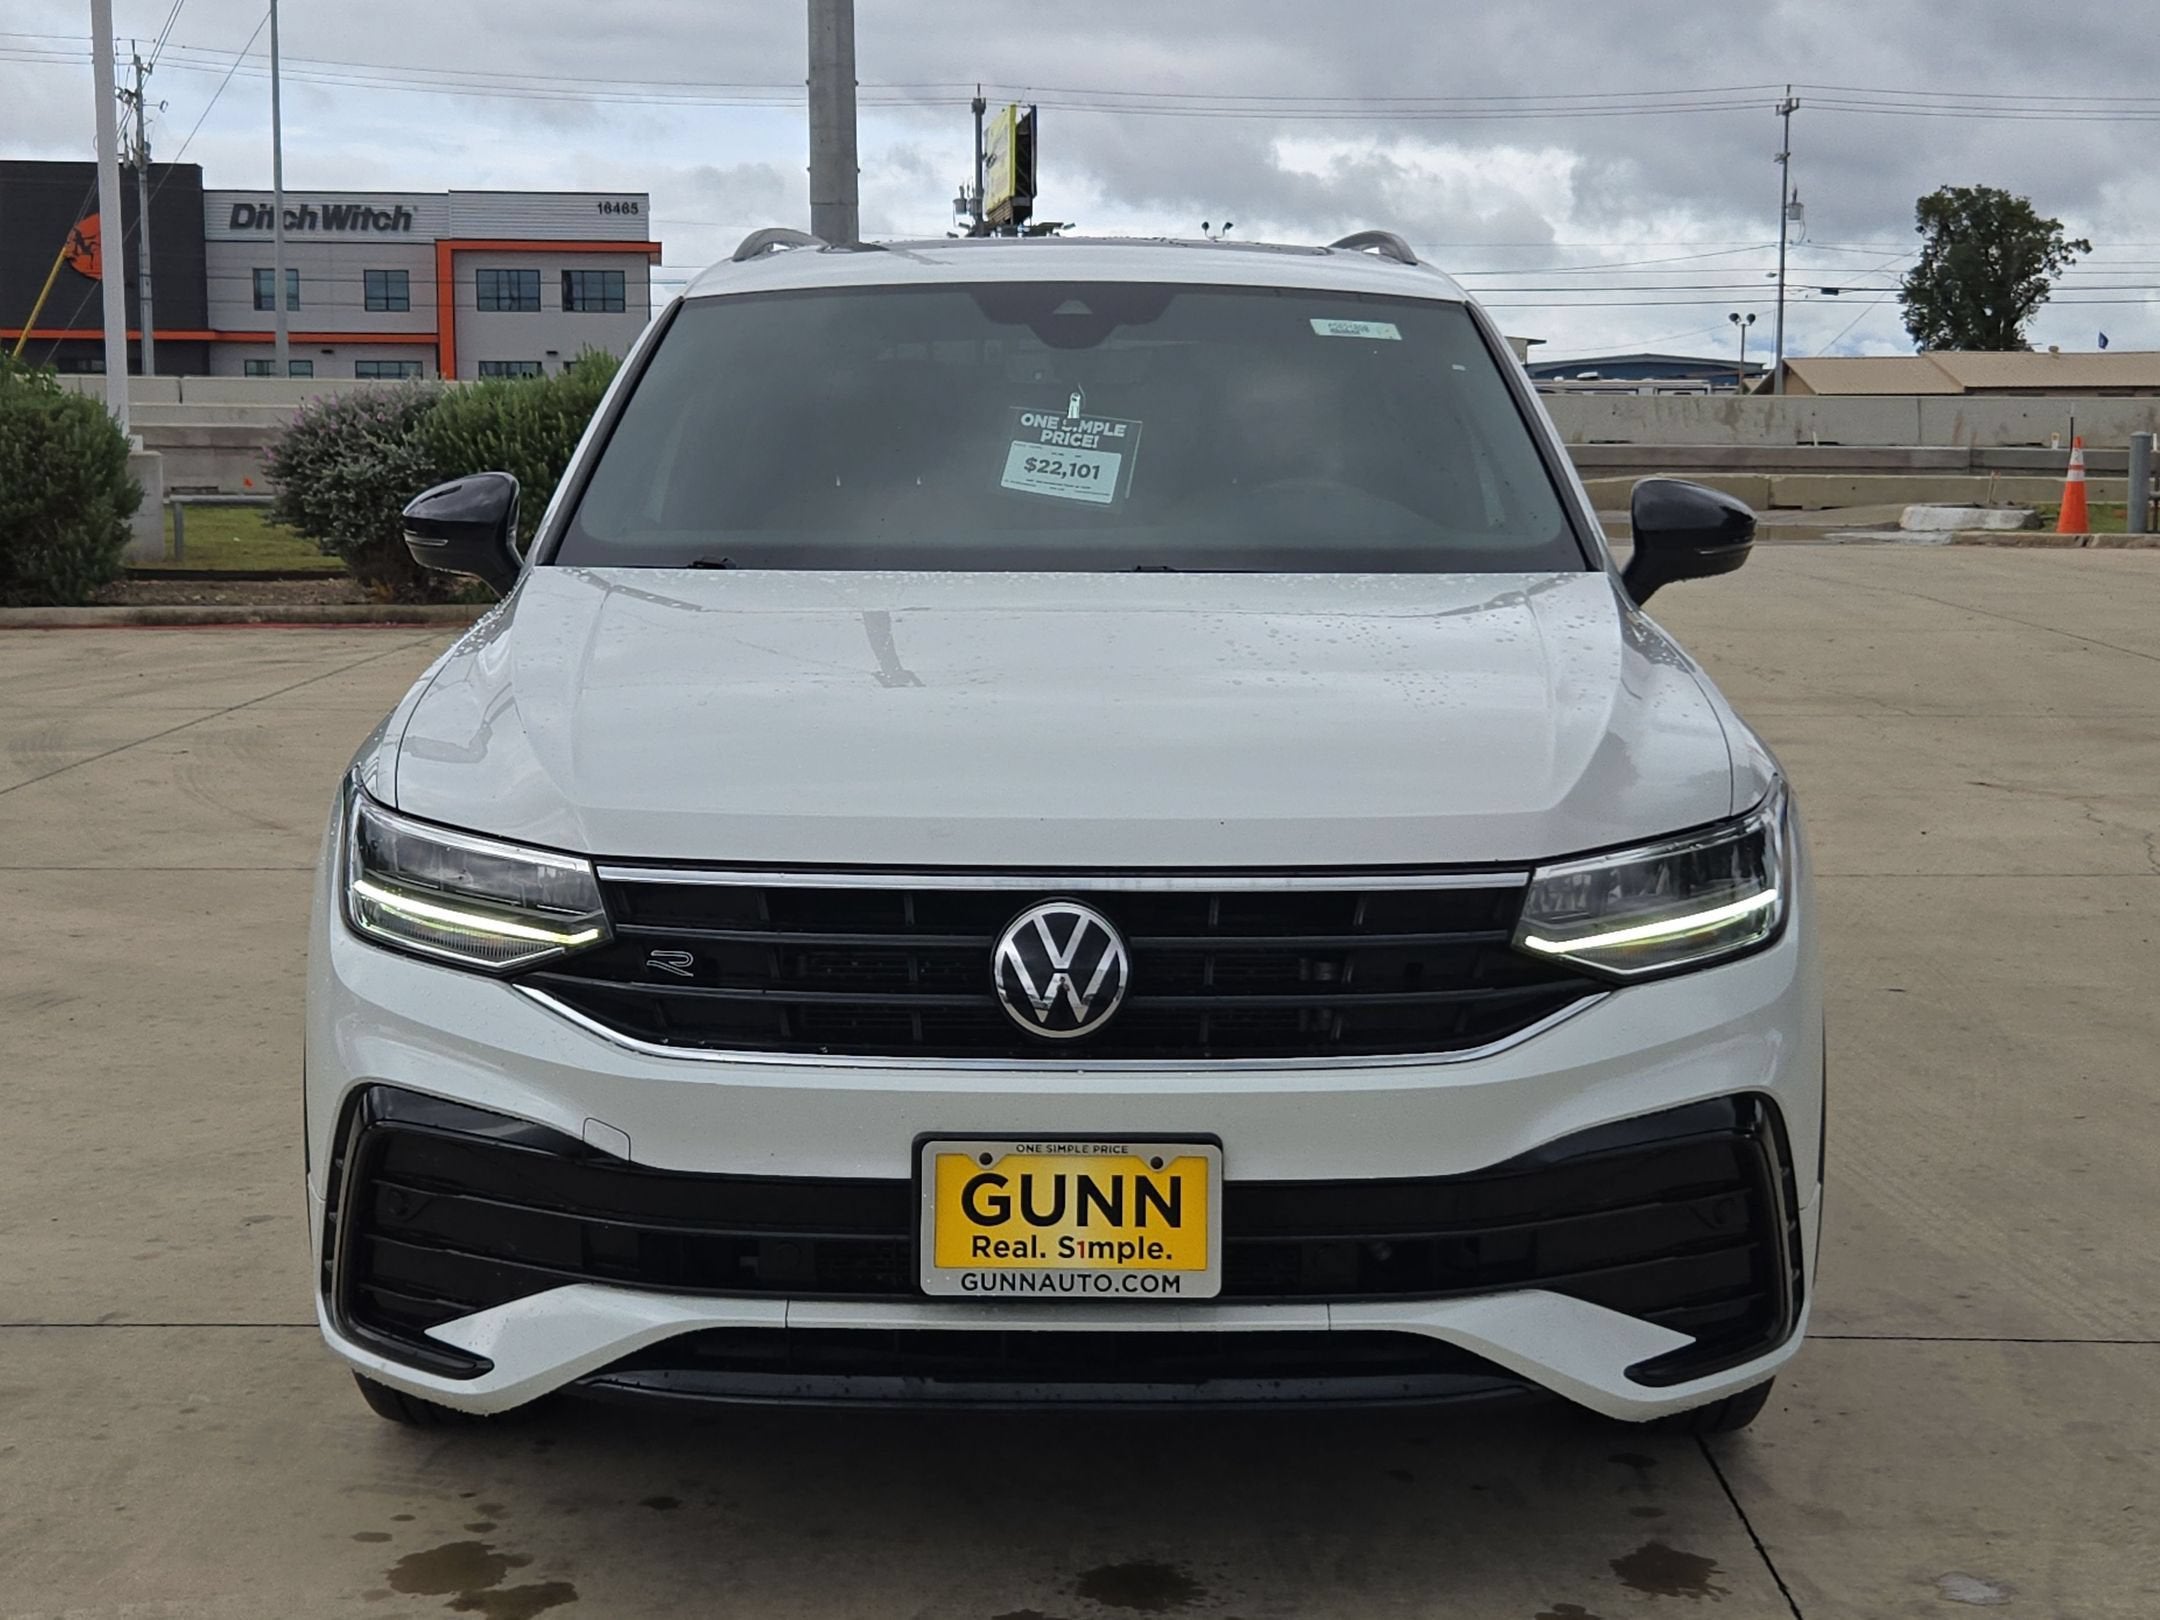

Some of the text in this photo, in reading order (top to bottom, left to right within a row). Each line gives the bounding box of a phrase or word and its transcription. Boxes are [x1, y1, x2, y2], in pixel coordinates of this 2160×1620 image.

[229, 203, 412, 231] Ditch Witch
[597, 201, 639, 215] 16465
[1020, 413, 1060, 430] ONE
[1040, 429, 1100, 449] PRICE!
[1023, 456, 1101, 480] $22,101
[1016, 1144, 1129, 1154] ONE SIMPLE PRICE
[961, 1172, 1182, 1228] GUNN
[972, 1235, 1046, 1259] Real.
[960, 1272, 1181, 1293] GUNNAUTO.COM
